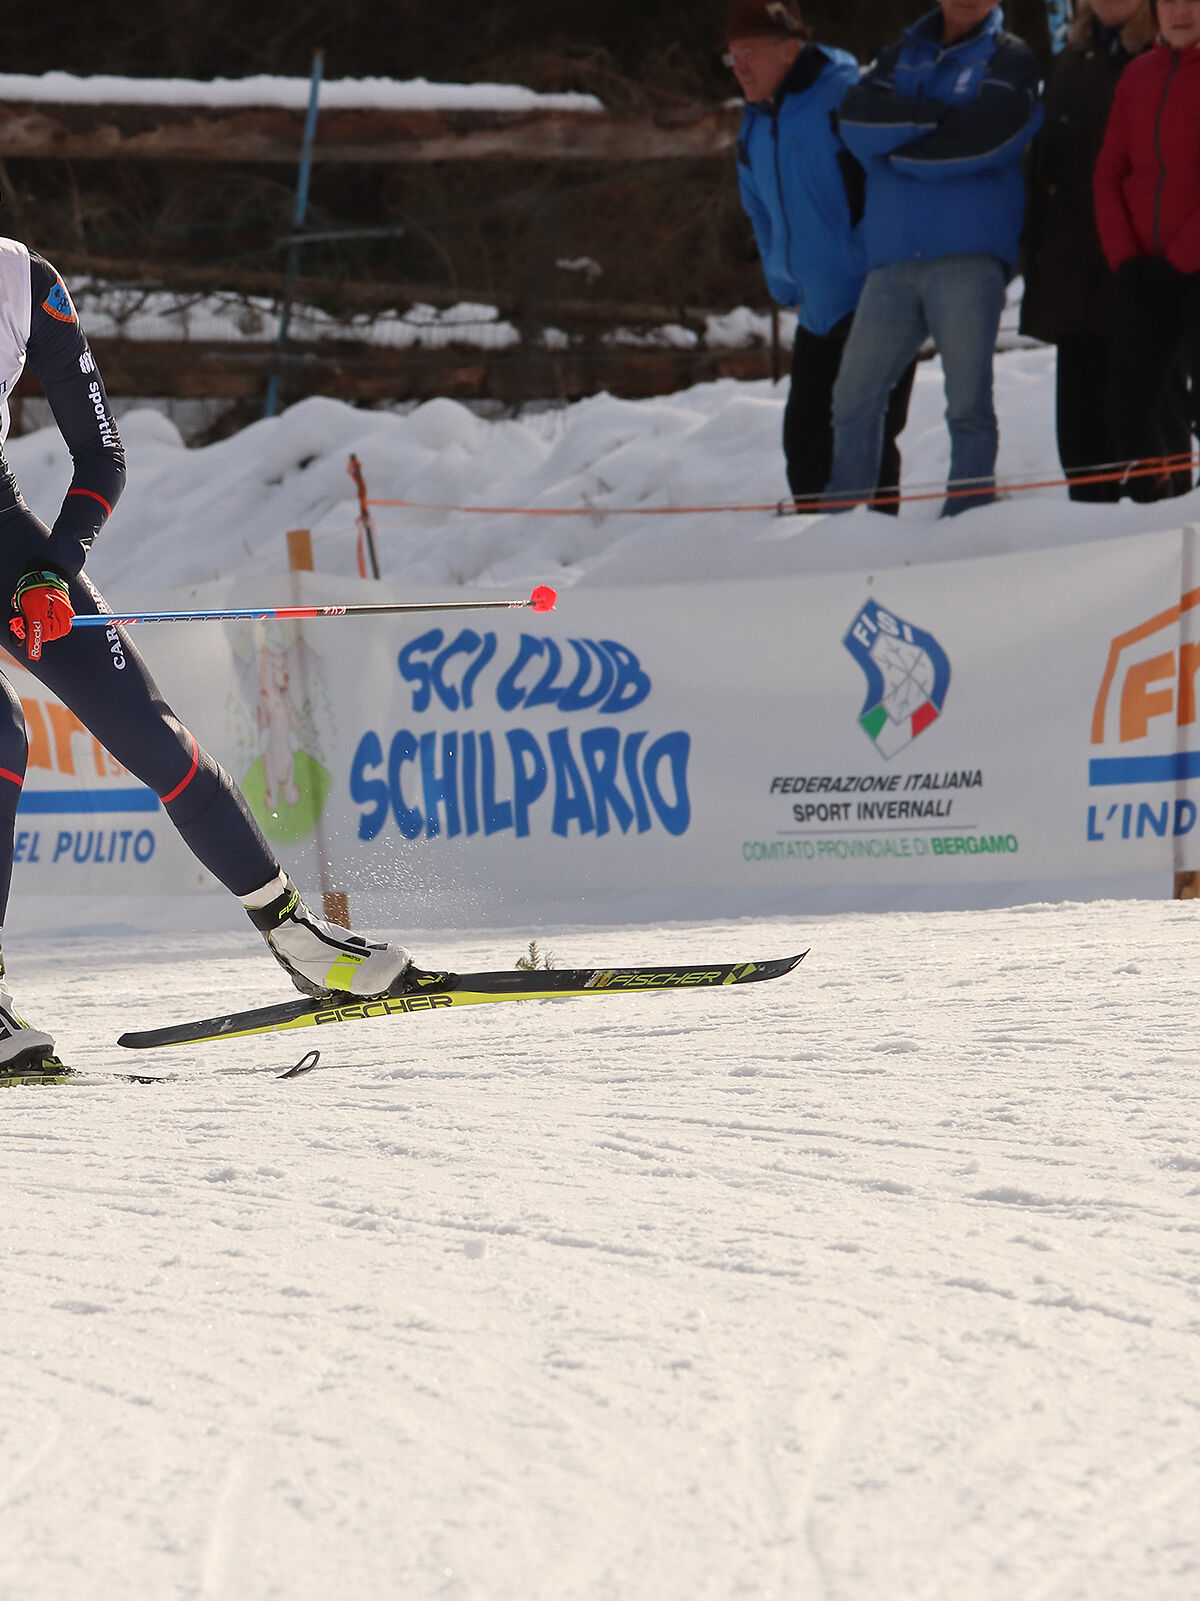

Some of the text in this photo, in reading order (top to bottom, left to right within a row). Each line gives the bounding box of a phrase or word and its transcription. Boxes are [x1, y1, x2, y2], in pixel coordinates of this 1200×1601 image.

[31, 620, 41, 658] Roeckl
[398, 628, 652, 714] SCI CLUB
[349, 726, 692, 842] SCHILPARIO
[769, 769, 984, 795] FEDERAZIONE ITALIANA
[793, 799, 953, 823] SPORT INVERNALI
[52, 829, 156, 863] PULITO
[742, 834, 1018, 862] COMITATO PROVINCIALE DI BERGAMO
[606, 970, 722, 988] FISCHER
[313, 994, 453, 1026] FISCHER
